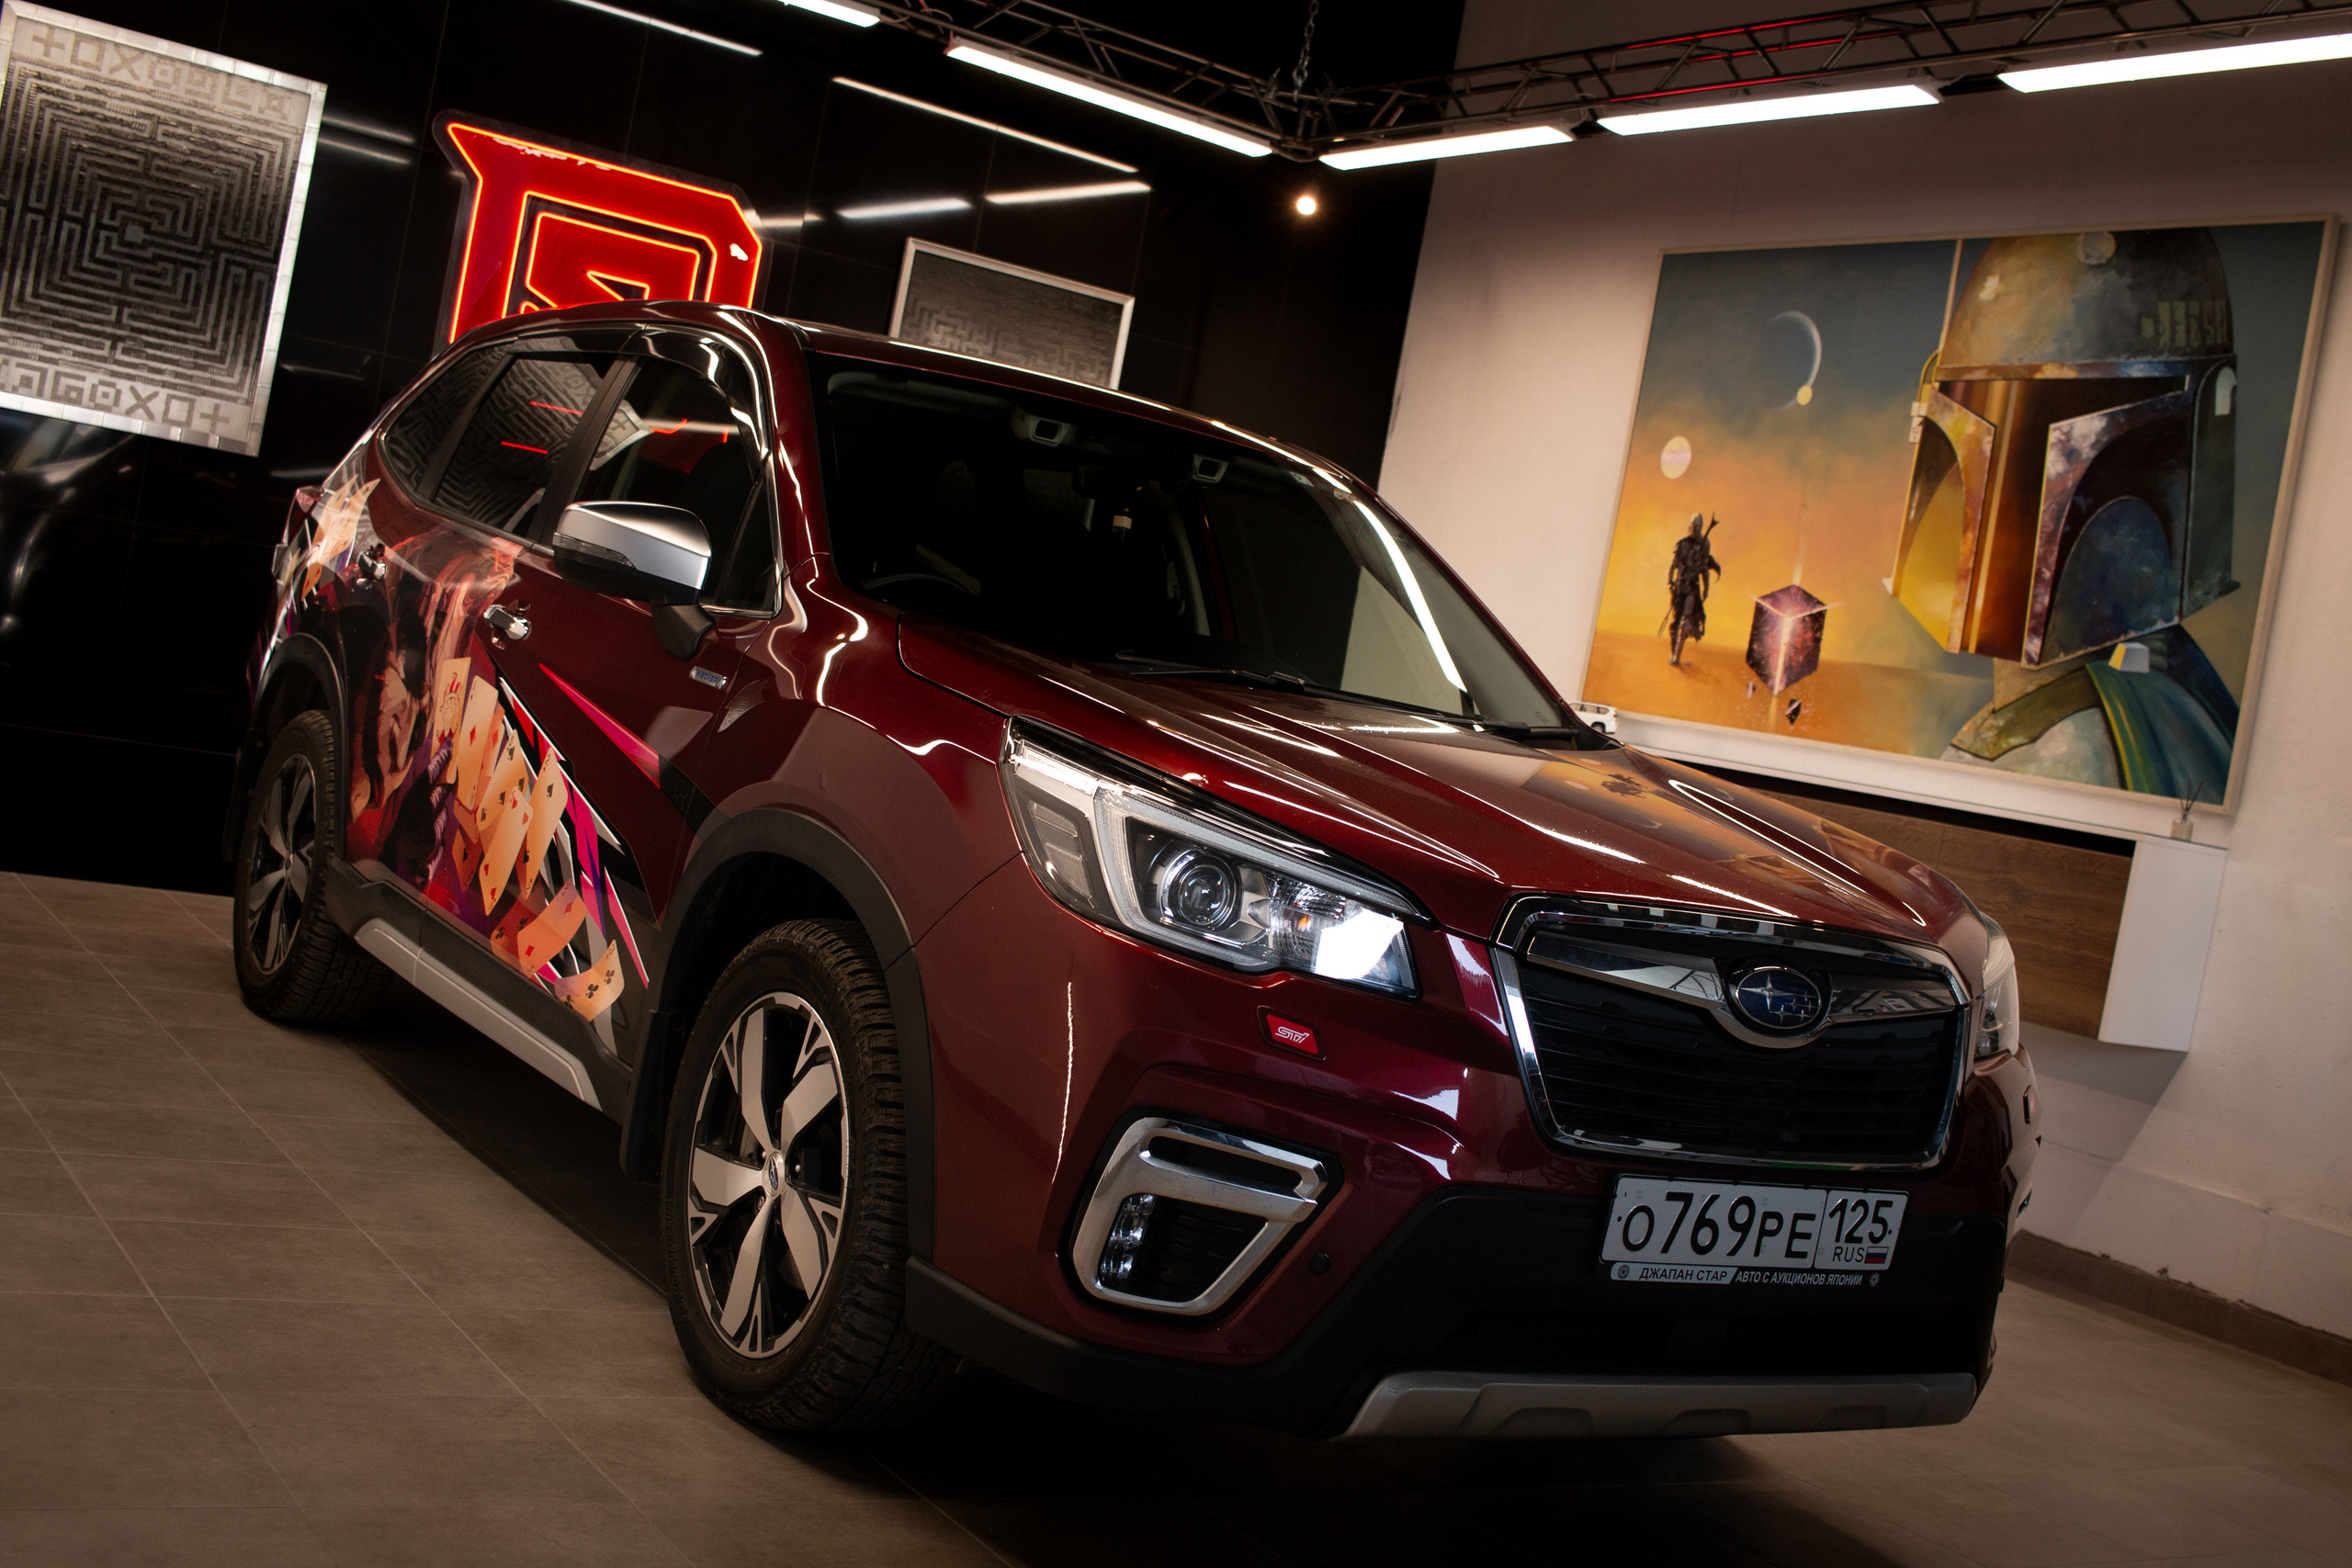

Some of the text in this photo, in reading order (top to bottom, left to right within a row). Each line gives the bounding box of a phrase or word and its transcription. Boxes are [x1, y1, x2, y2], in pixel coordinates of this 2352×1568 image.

[1828, 1198, 1894, 1244] 125
[1831, 1246, 1865, 1262] RUS
[1639, 1266, 1863, 1287] ДЖАПАН СТАР АВТО С АУКЦИОНОВ ЯПОНИИ
